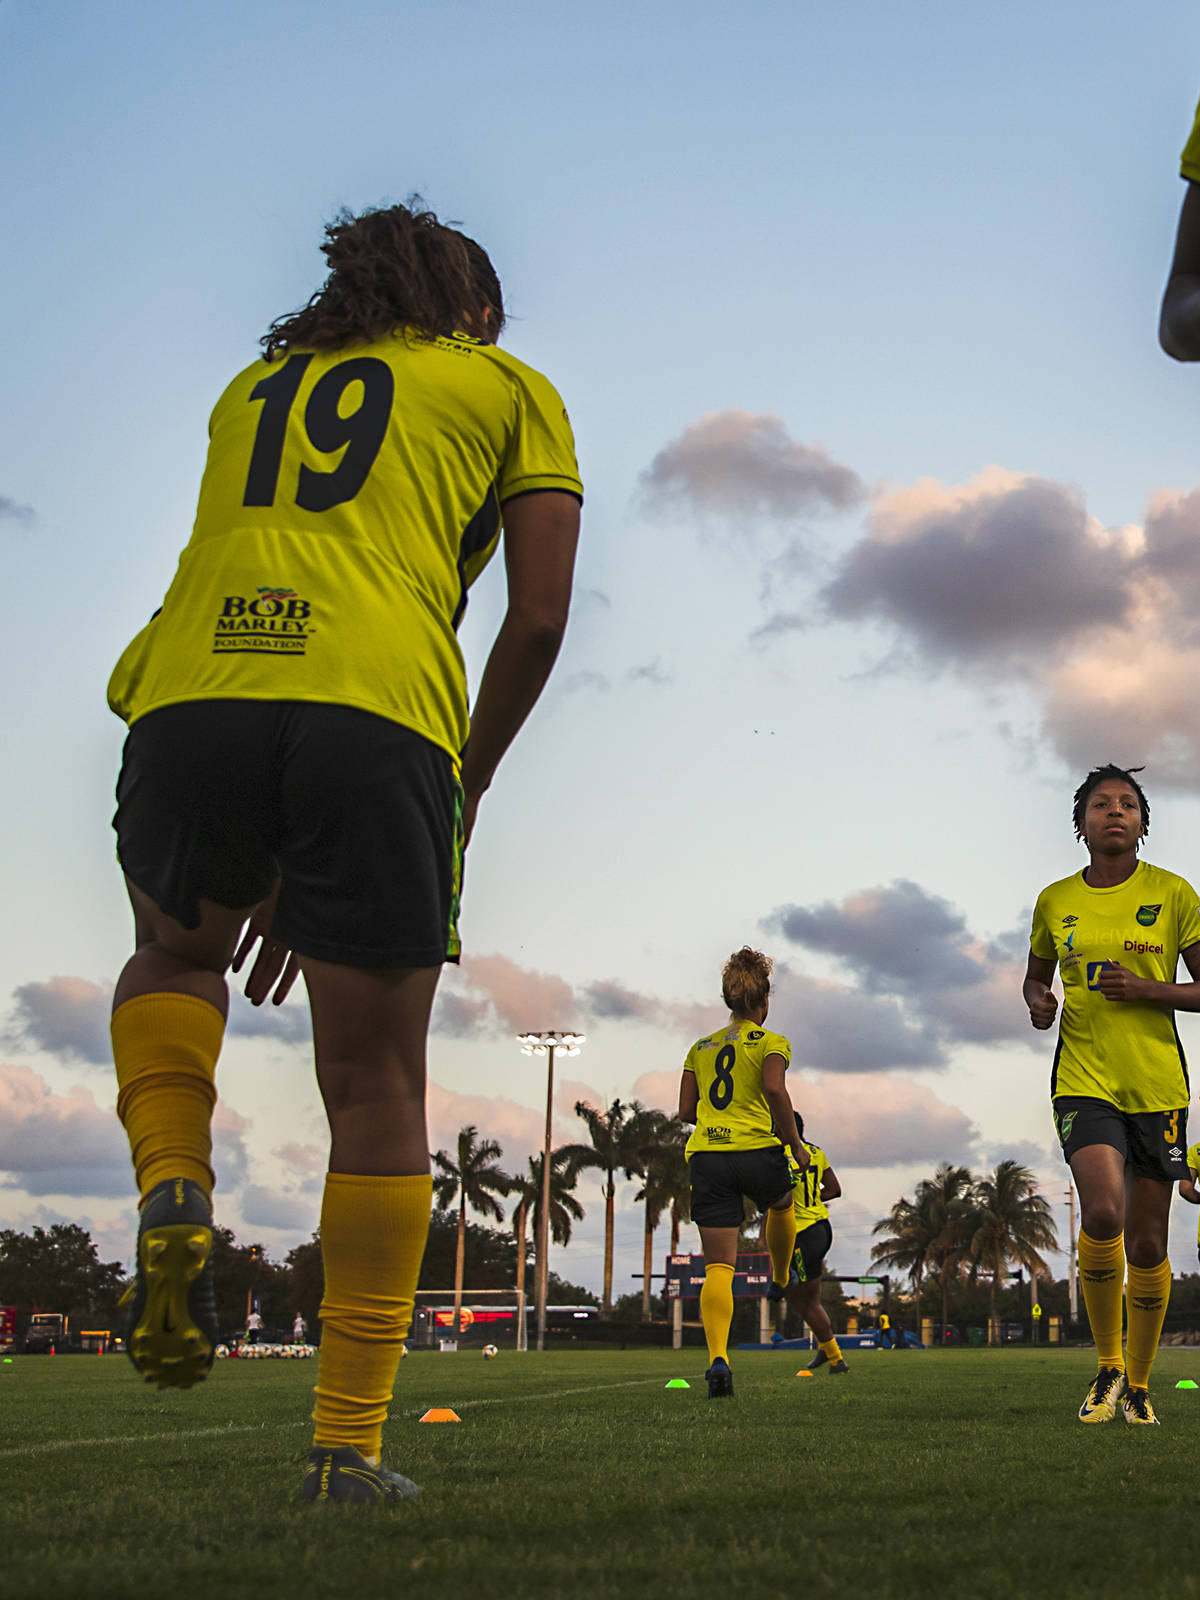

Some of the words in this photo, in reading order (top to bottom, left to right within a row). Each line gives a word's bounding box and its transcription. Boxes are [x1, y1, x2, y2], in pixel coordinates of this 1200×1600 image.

[242, 353, 395, 513] 19
[218, 596, 312, 620] BOB
[216, 618, 309, 633] MARLEY
[213, 638, 306, 649] FOUNDATION
[1124, 940, 1164, 955] Digicel
[709, 1044, 736, 1111] 8
[1163, 1110, 1179, 1144] 3
[801, 1165, 818, 1207] 17
[671, 1256, 691, 1264] HOME
[320, 1454, 332, 1500] TIEMPO
